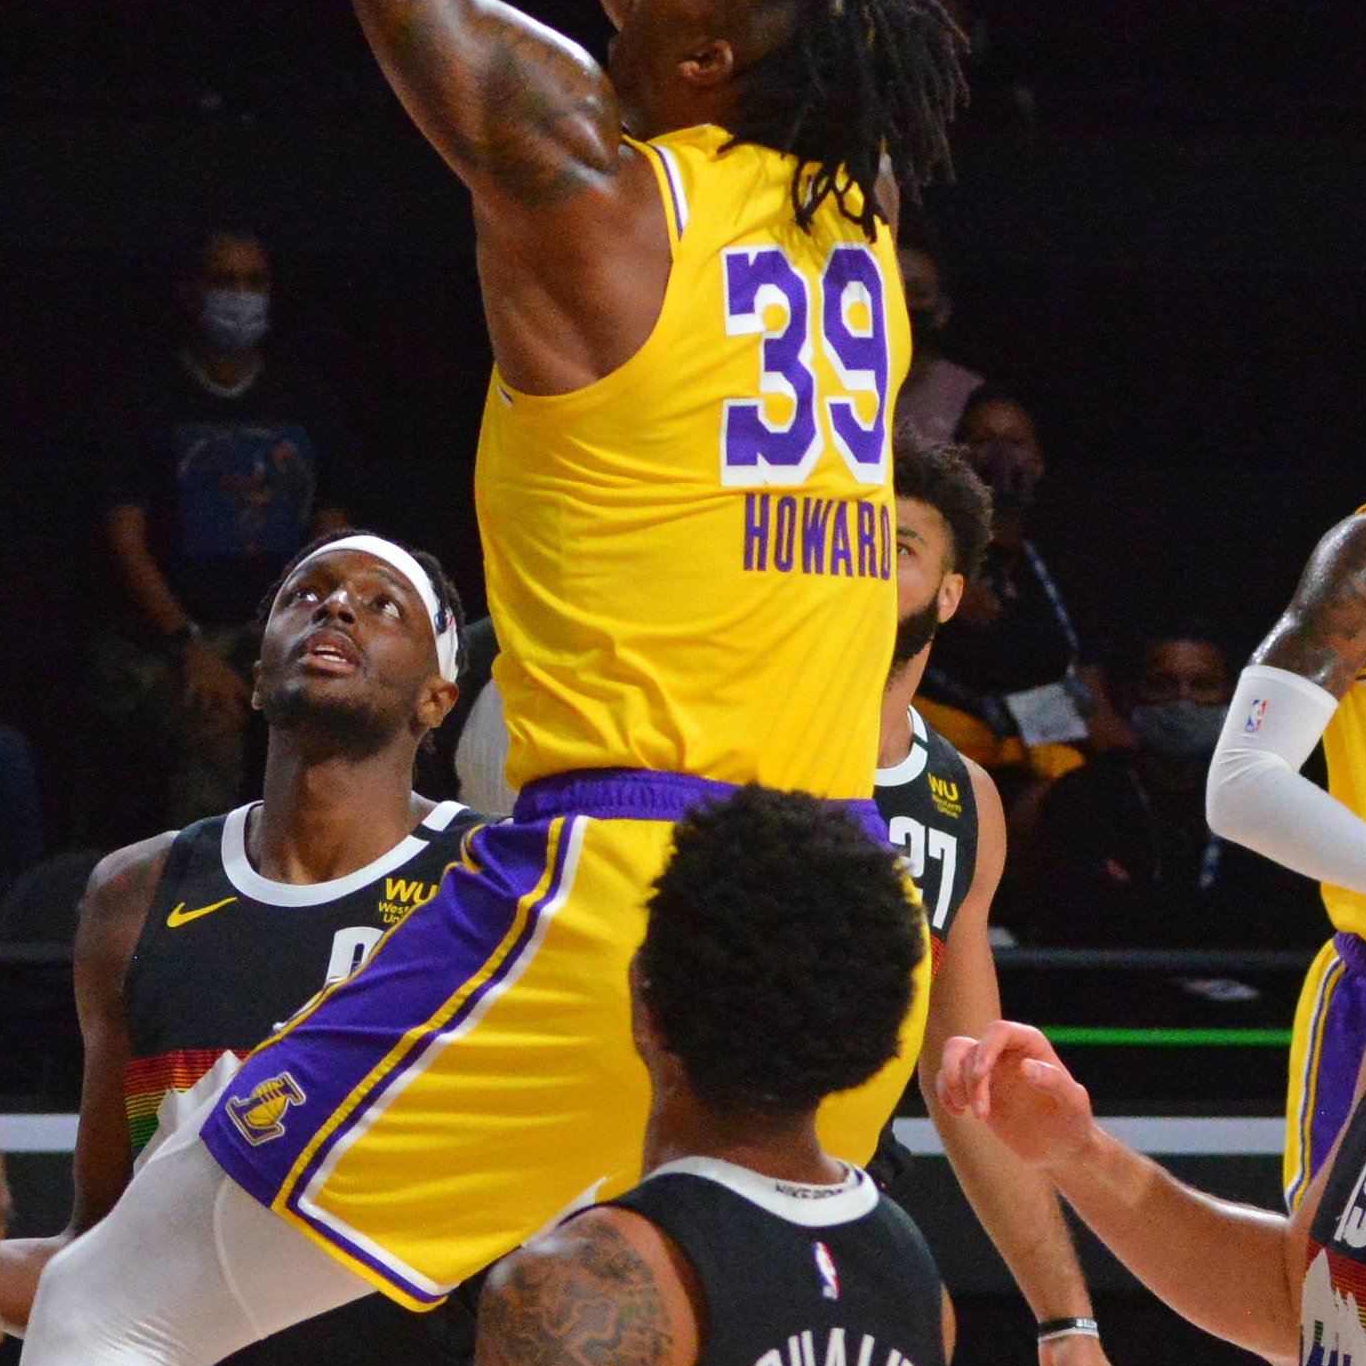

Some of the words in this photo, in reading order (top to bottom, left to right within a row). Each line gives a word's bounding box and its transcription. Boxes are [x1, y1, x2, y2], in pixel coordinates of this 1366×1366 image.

[720, 241, 890, 487] 39
[743, 493, 891, 581] HOWARD
[385, 877, 439, 905] WU
